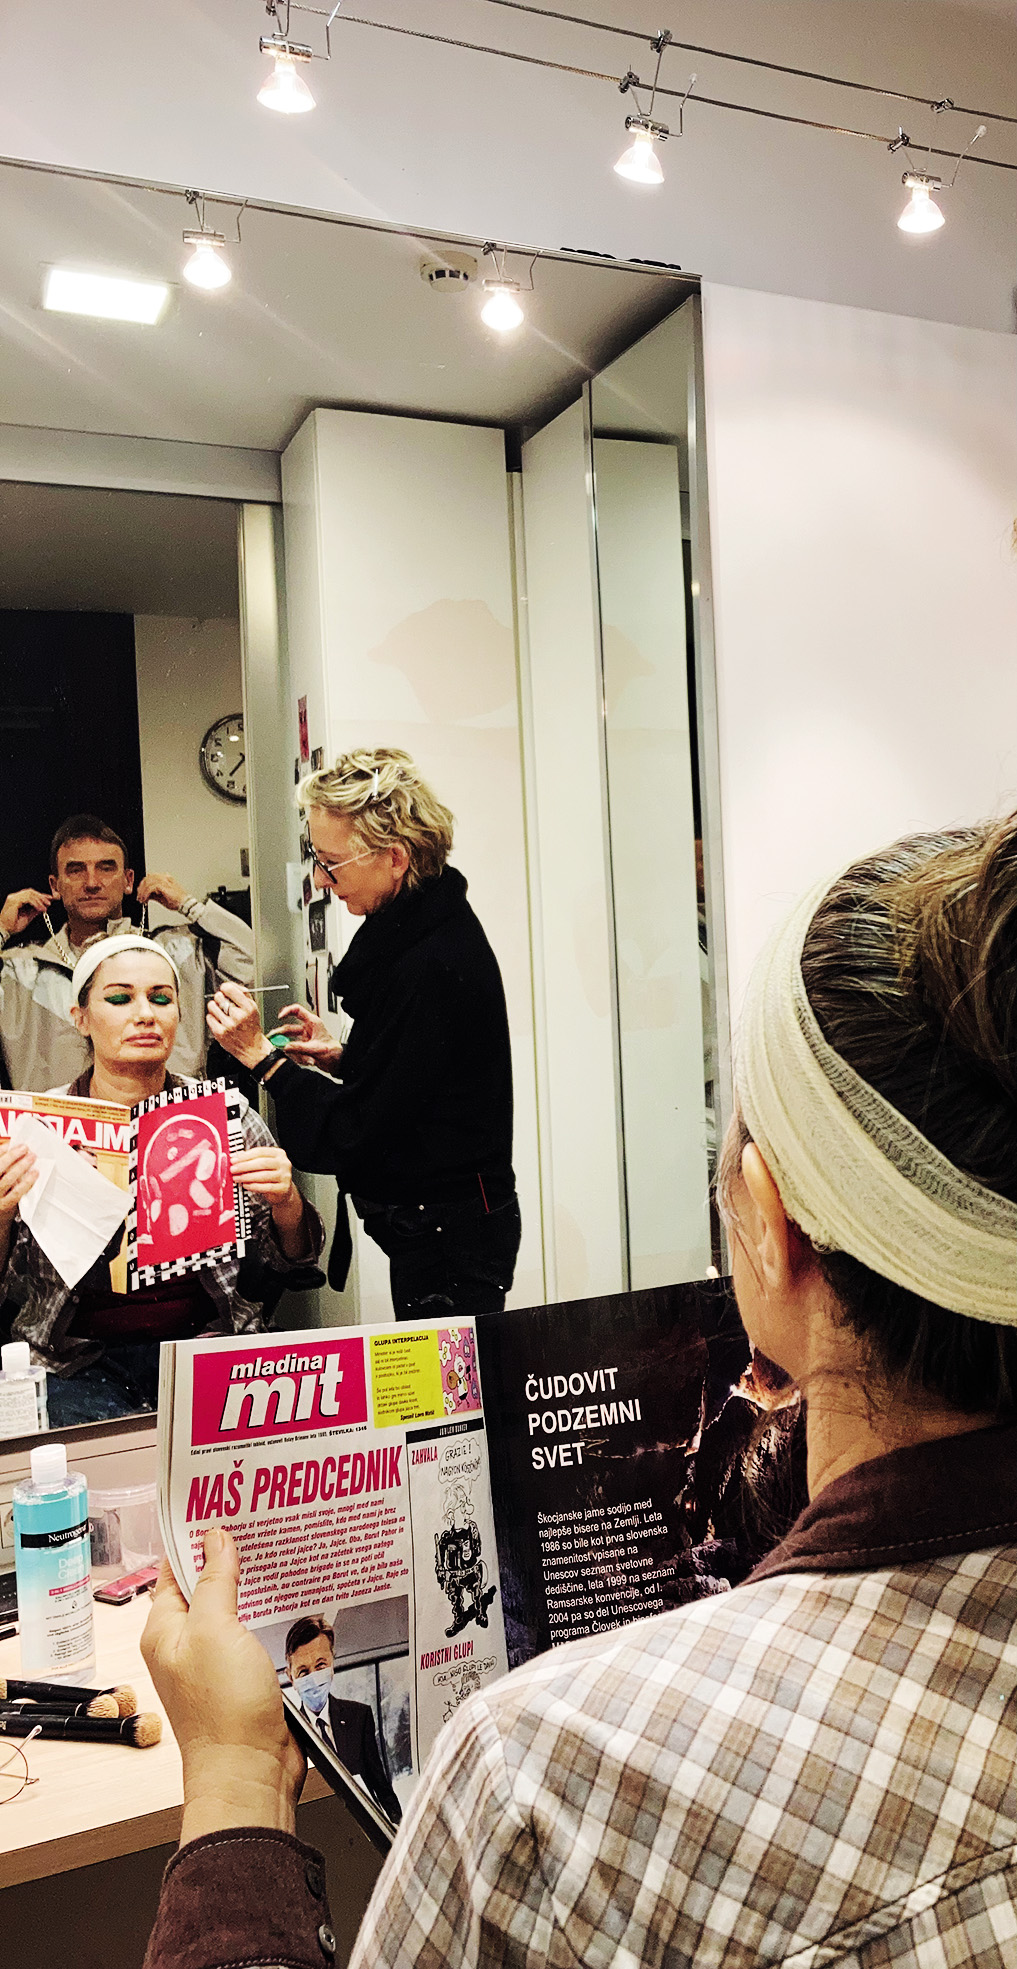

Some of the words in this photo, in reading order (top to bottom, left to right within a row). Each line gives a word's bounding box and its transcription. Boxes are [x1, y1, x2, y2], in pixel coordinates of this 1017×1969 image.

[230, 1353, 323, 1380] mladina
[219, 1353, 344, 1432] mit
[525, 1367, 618, 1401] ČUDOVIT
[527, 1398, 641, 1436] PODZEMNI
[411, 1446, 438, 1465] ZAHVALA
[531, 1441, 585, 1470] SVET
[186, 1459, 244, 1522] NAŠ
[250, 1445, 402, 1512] PREDCEDNIK
[249, 1520, 255, 1529] si
[257, 1516, 283, 1527] verjetno
[285, 1513, 300, 1524] vsak
[301, 1510, 317, 1520] misli
[319, 1507, 335, 1517] svoje,
[338, 1502, 355, 1512] mnogi
[356, 1501, 369, 1509] med
[370, 1498, 384, 1506] nami
[257, 1529, 277, 1538] vržete
[279, 1525, 302, 1534] kamen,
[304, 1519, 334, 1532] pomislite,
[336, 1517, 346, 1525] kdo
[348, 1513, 360, 1522] med
[362, 1510, 377, 1519] nami
[377, 1509, 382, 1518] je
[384, 1507, 396, 1515] brez
[537, 1511, 583, 1524] Škocjanske
[584, 1507, 605, 1520] jame
[606, 1502, 632, 1515] sodijo
[634, 1498, 652, 1511] med
[538, 1525, 572, 1539] najlepše
[573, 1522, 600, 1534] bisere
[601, 1520, 612, 1530] na
[614, 1514, 642, 1529] Zemlji.
[644, 1511, 663, 1523] Leta
[241, 1540, 273, 1552] utelešena
[275, 1534, 309, 1546] razklanost
[311, 1528, 347, 1540] slovenskega
[349, 1521, 380, 1532] narodnega
[255, 1553, 262, 1561] Je
[264, 1550, 277, 1558] kdo
[279, 1546, 296, 1556] rekel
[297, 1543, 317, 1555] jajce?
[318, 1542, 328, 1550] Ja,
[330, 1539, 347, 1548] Jajce.
[349, 1535, 362, 1543] Oba,
[364, 1531, 380, 1541] Borut
[381, 1528, 398, 1537] Pahor
[541, 1541, 561, 1552] 1986
[562, 1541, 572, 1550] so
[574, 1537, 589, 1548] bile
[590, 1536, 604, 1547] kot
[606, 1532, 624, 1546] prva
[626, 1524, 668, 1541] slovenska
[244, 1576, 261, 1587] Jajce
[263, 1572, 279, 1582] vodil
[360, 1554, 372, 1563] poti
[246, 1561, 278, 1575] prisegala
[290, 1557, 307, 1566] Jajce
[321, 1552, 328, 1560] na
[330, 1548, 353, 1558] začetek
[355, 1543, 372, 1553] vsega
[373, 1539, 394, 1550] našega
[542, 1551, 591, 1567] znamenitost
[593, 1548, 626, 1563] vpisane
[627, 1545, 638, 1554] na
[543, 1569, 579, 1581] Unescov
[580, 1563, 614, 1576] seznam
[615, 1556, 654, 1571] svetovne
[264, 1596, 273, 1604] od
[300, 1583, 335, 1597] zunanjosti,
[337, 1578, 360, 1590] spočeta
[367, 1574, 384, 1583] Jajcu.
[386, 1571, 399, 1580] Raje
[292, 1576, 322, 1587] contraire
[332, 1570, 349, 1579] Borut
[369, 1564, 375, 1573] je
[377, 1562, 388, 1570] bila
[389, 1559, 403, 1567] naša
[545, 1582, 587, 1596] dediščine,
[588, 1579, 604, 1590] leta
[606, 1573, 627, 1587] 1999
[629, 1573, 640, 1583] na
[642, 1566, 675, 1581] seznam
[253, 1608, 272, 1618] Boruta
[273, 1602, 298, 1614] Pahorja
[300, 1599, 310, 1608] kot
[312, 1597, 320, 1605] en
[322, 1595, 334, 1603] dan
[351, 1588, 371, 1598] Janeza
[373, 1583, 392, 1592] Janše.
[546, 1595, 594, 1609] Ramsarske
[595, 1586, 643, 1604] konvencije,
[644, 1583, 656, 1595] od
[548, 1612, 569, 1623] 2004
[571, 1611, 582, 1623] pa
[584, 1610, 595, 1619] so
[596, 1606, 609, 1618] del
[611, 1597, 664, 1615] Unescovega
[550, 1623, 590, 1640] programa
[591, 1619, 622, 1633] Človek
[421, 1646, 451, 1670] KORISTNI
[454, 1640, 473, 1660] GLUPI
